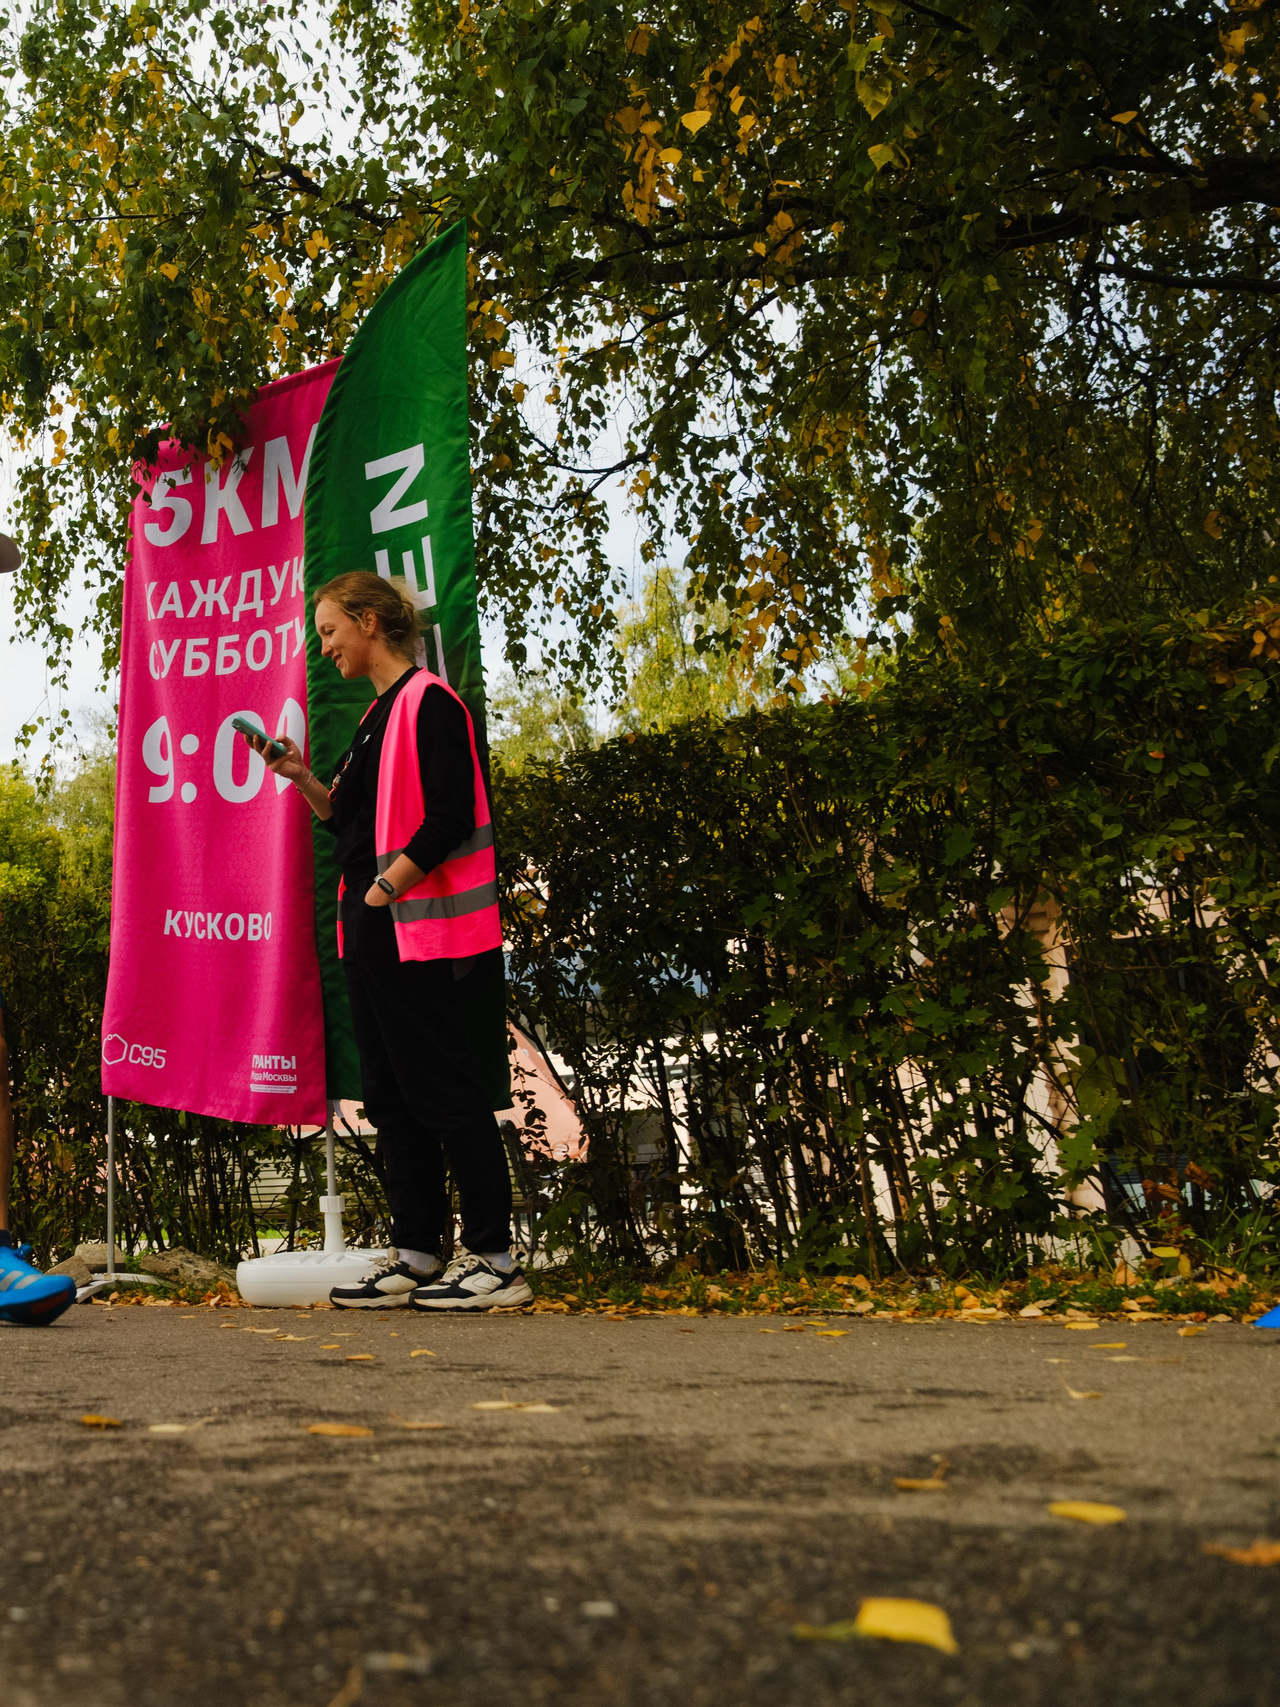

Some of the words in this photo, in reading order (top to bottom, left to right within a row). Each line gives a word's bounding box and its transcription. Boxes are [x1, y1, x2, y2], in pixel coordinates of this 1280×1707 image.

[144, 422, 319, 547] 5КМ
[149, 616, 306, 680] СУББОТУ
[142, 697, 306, 804] 9:00
[163, 909, 272, 941] КУСКОВО
[251, 1054, 297, 1070] ГРАНТЫ
